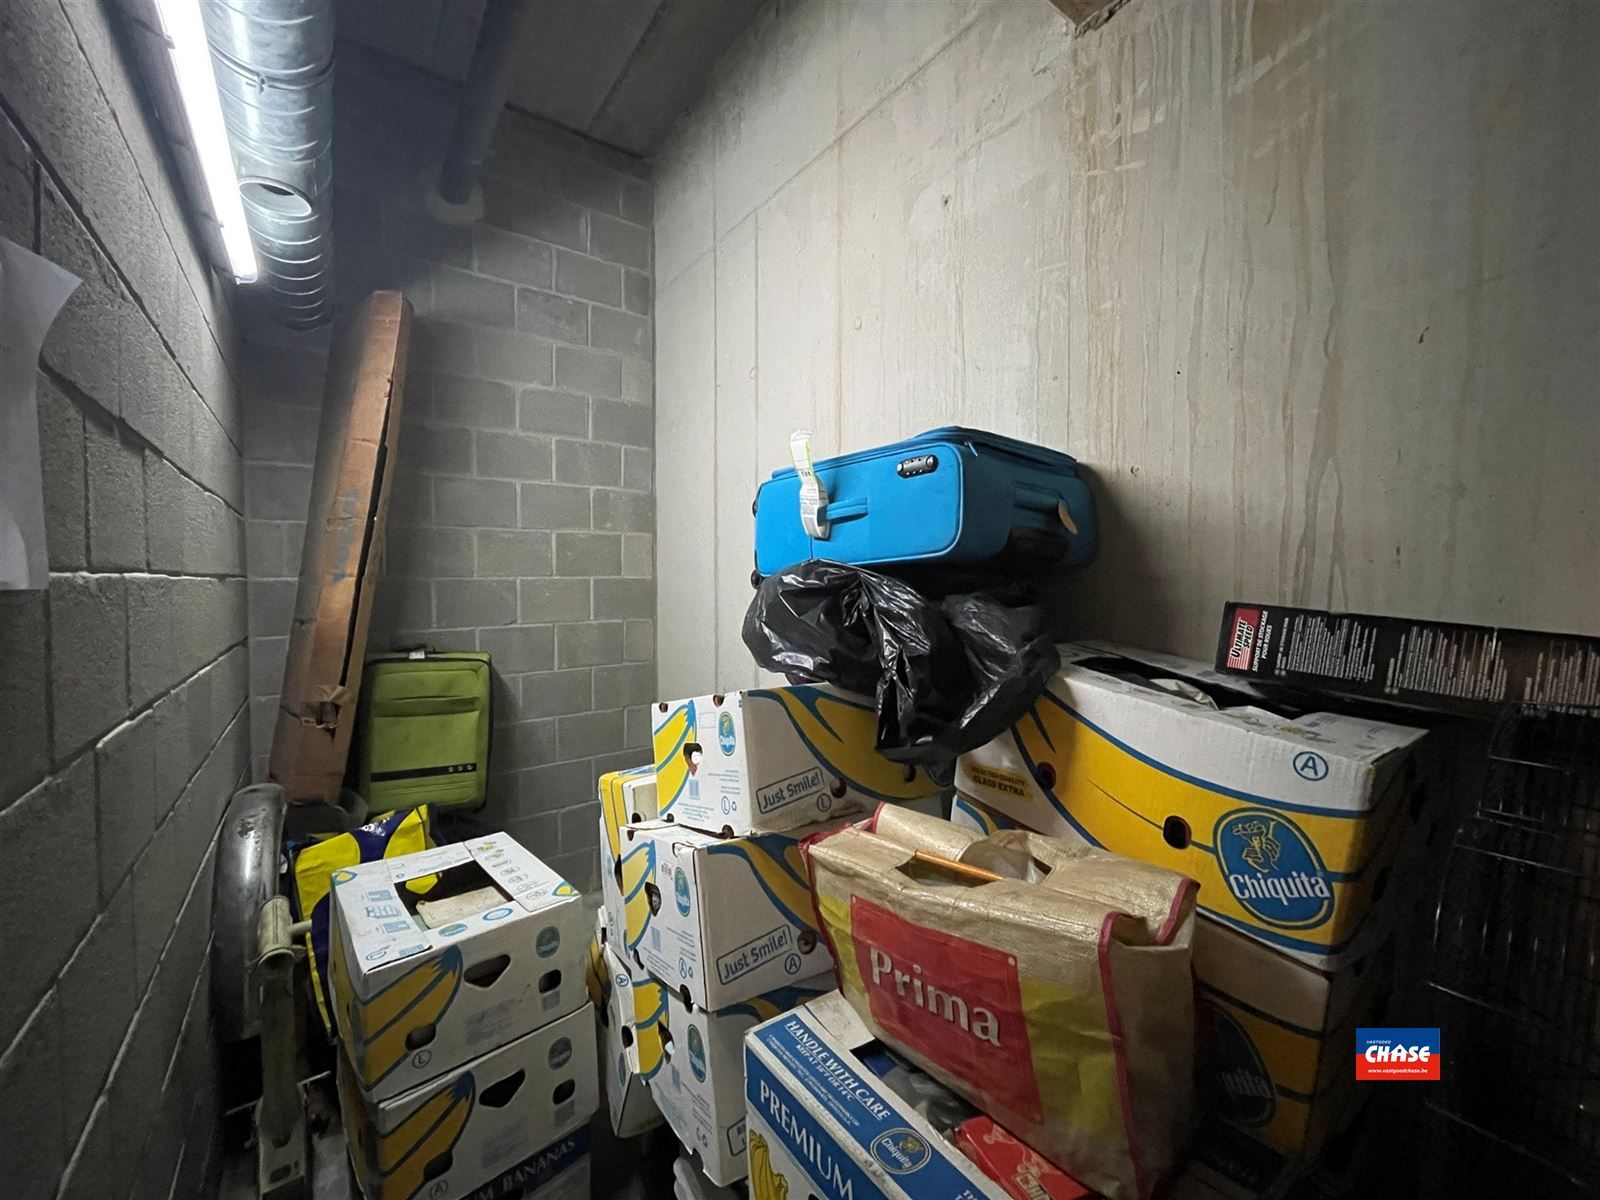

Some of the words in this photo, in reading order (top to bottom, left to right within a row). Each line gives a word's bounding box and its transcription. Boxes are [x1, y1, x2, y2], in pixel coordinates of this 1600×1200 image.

[1231, 620, 1247, 658] ULTIMATE
[1243, 625, 1254, 648] SPEED
[1258, 610, 1268, 640] STOCKAGE
[1264, 625, 1273, 643] ROUES
[1256, 639, 1263, 647] DE
[1261, 643, 1269, 659] POUR
[1252, 647, 1261, 672] SUPPORT
[1300, 755, 1322, 777] A
[763, 787, 786, 809] Just
[786, 771, 819, 799] Smile!
[998, 782, 1024, 796] EXTRA
[1228, 872, 1330, 905] Chiquita
[723, 953, 749, 979] Just
[750, 933, 788, 962] Smile!
[870, 946, 1001, 1047] Prima
[786, 1020, 830, 1059] HANDLE
[825, 1058, 859, 1089] WITH
[855, 1088, 891, 1120] CARE
[760, 1079, 855, 1200] PREMIUM
[881, 1138, 912, 1169] Chiquita
